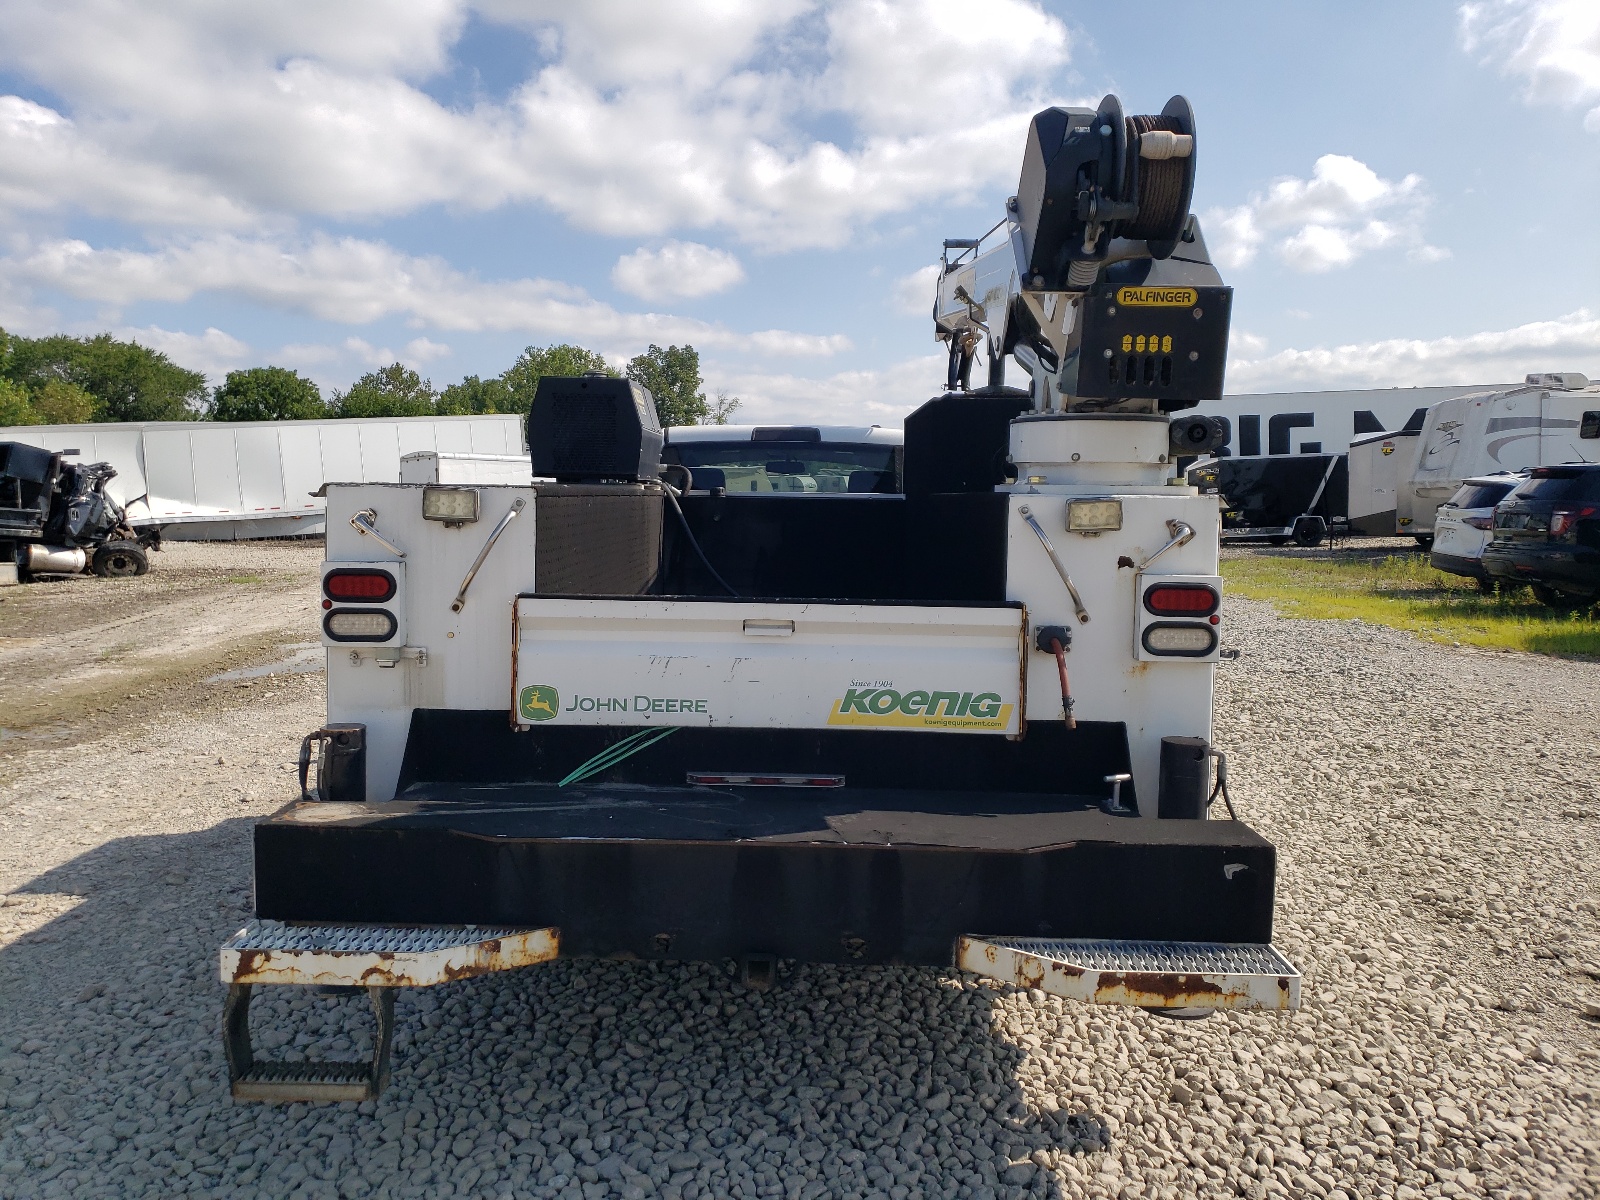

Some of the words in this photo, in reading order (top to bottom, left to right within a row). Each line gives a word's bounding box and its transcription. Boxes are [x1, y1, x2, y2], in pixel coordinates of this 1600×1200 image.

[1123, 290, 1191, 303] PALFINGER
[1211, 411, 1321, 456] IG
[849, 678, 872, 687] Since
[873, 680, 894, 688] 1904
[565, 694, 628, 712] JOHN
[634, 695, 708, 713] DEERE
[924, 718, 1002, 728] koenigequipment.com
